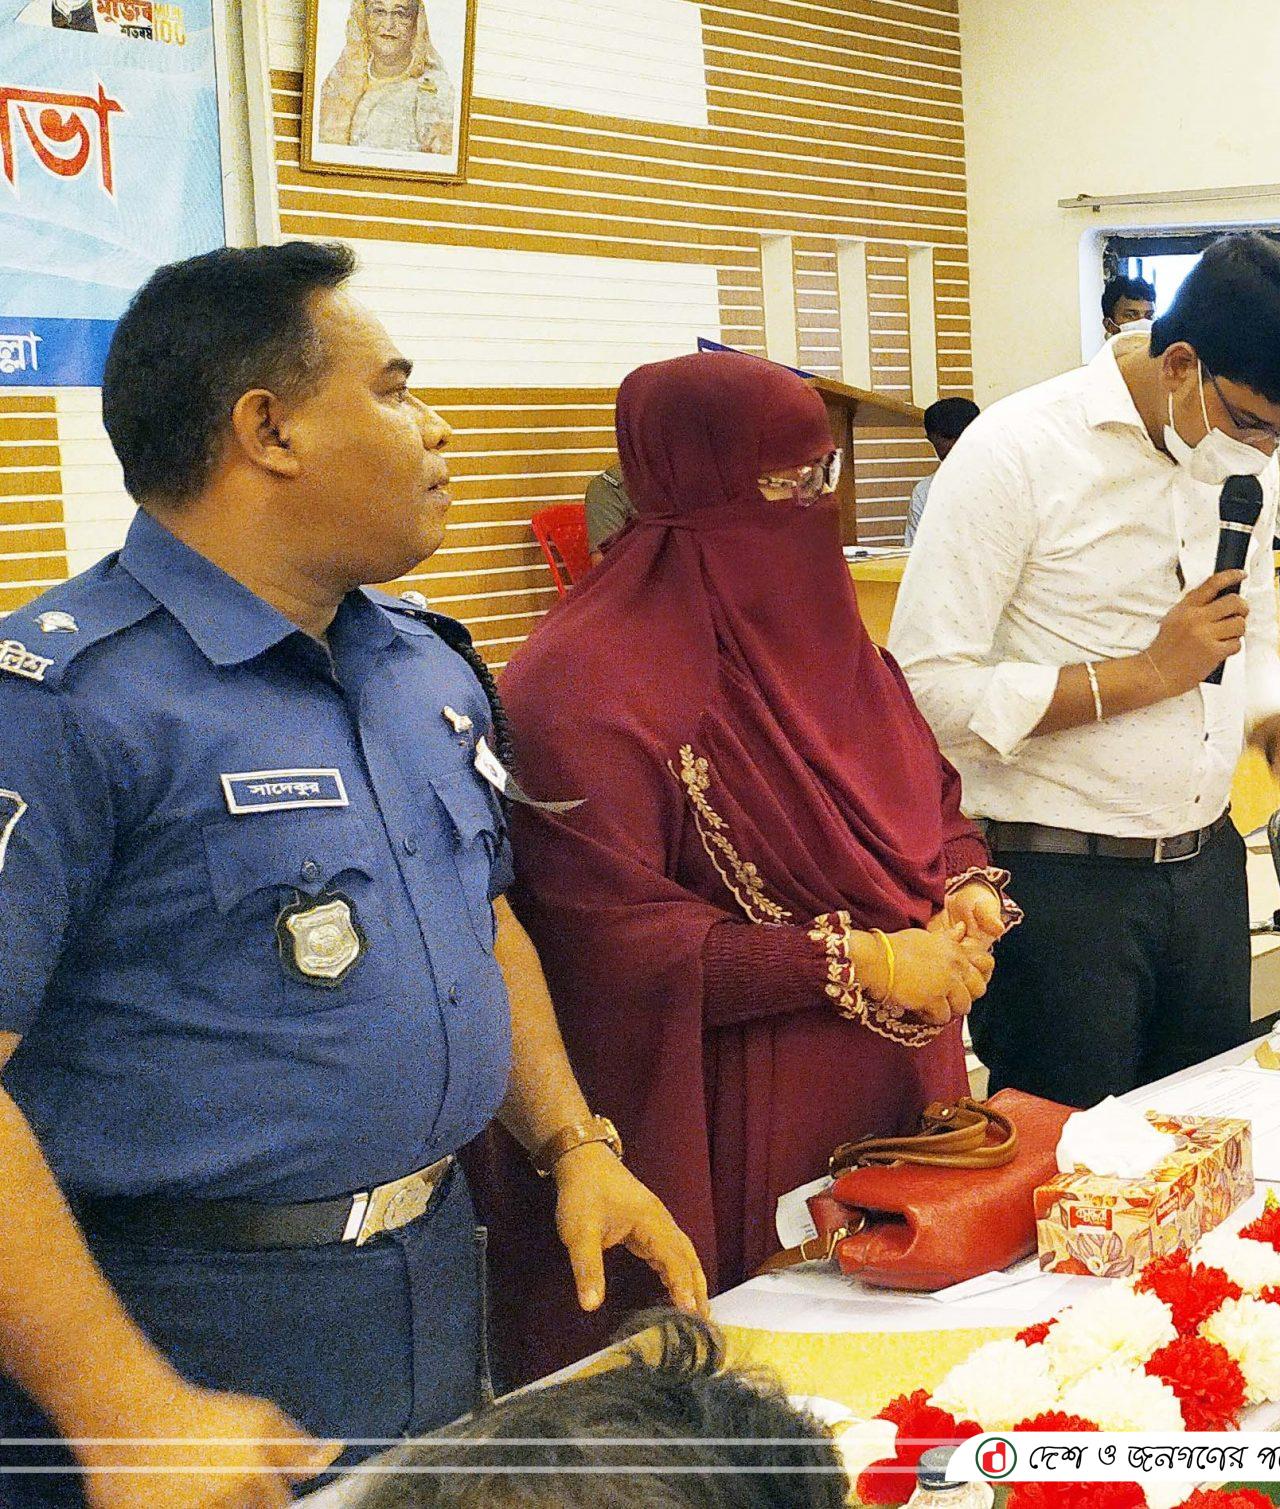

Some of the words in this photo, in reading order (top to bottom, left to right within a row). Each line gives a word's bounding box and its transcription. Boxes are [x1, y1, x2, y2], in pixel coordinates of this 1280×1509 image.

[0, 331, 43, 373] ল্লা
[0, 640, 54, 681] লিশ
[246, 782, 320, 796] সাদেকুর
